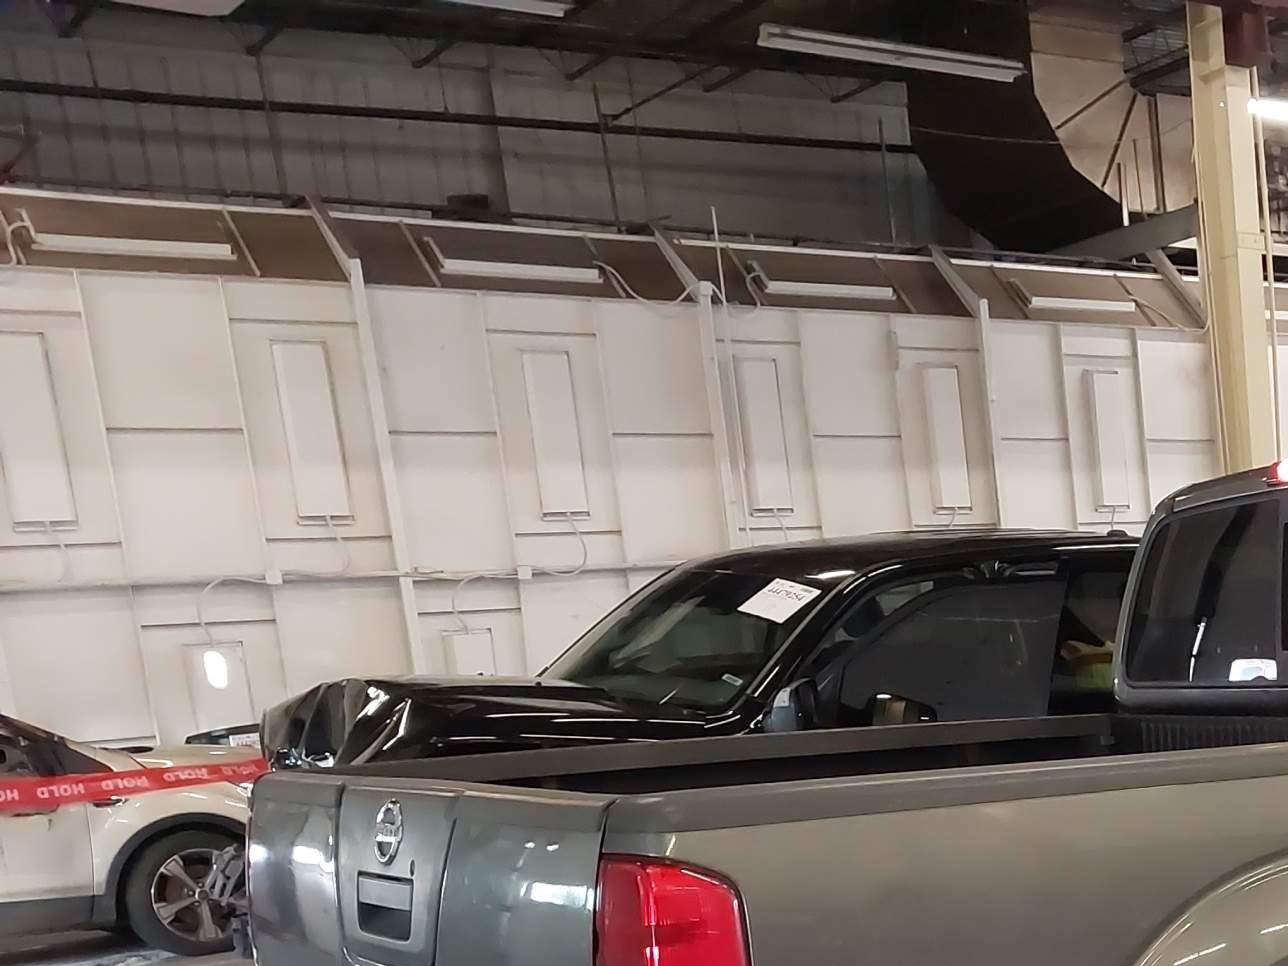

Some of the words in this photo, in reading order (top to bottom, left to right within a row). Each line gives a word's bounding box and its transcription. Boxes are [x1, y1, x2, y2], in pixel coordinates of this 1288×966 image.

[163, 767, 208, 782] HOLD
[36, 783, 85, 799] HOLD
[101, 775, 149, 791] HOLD
